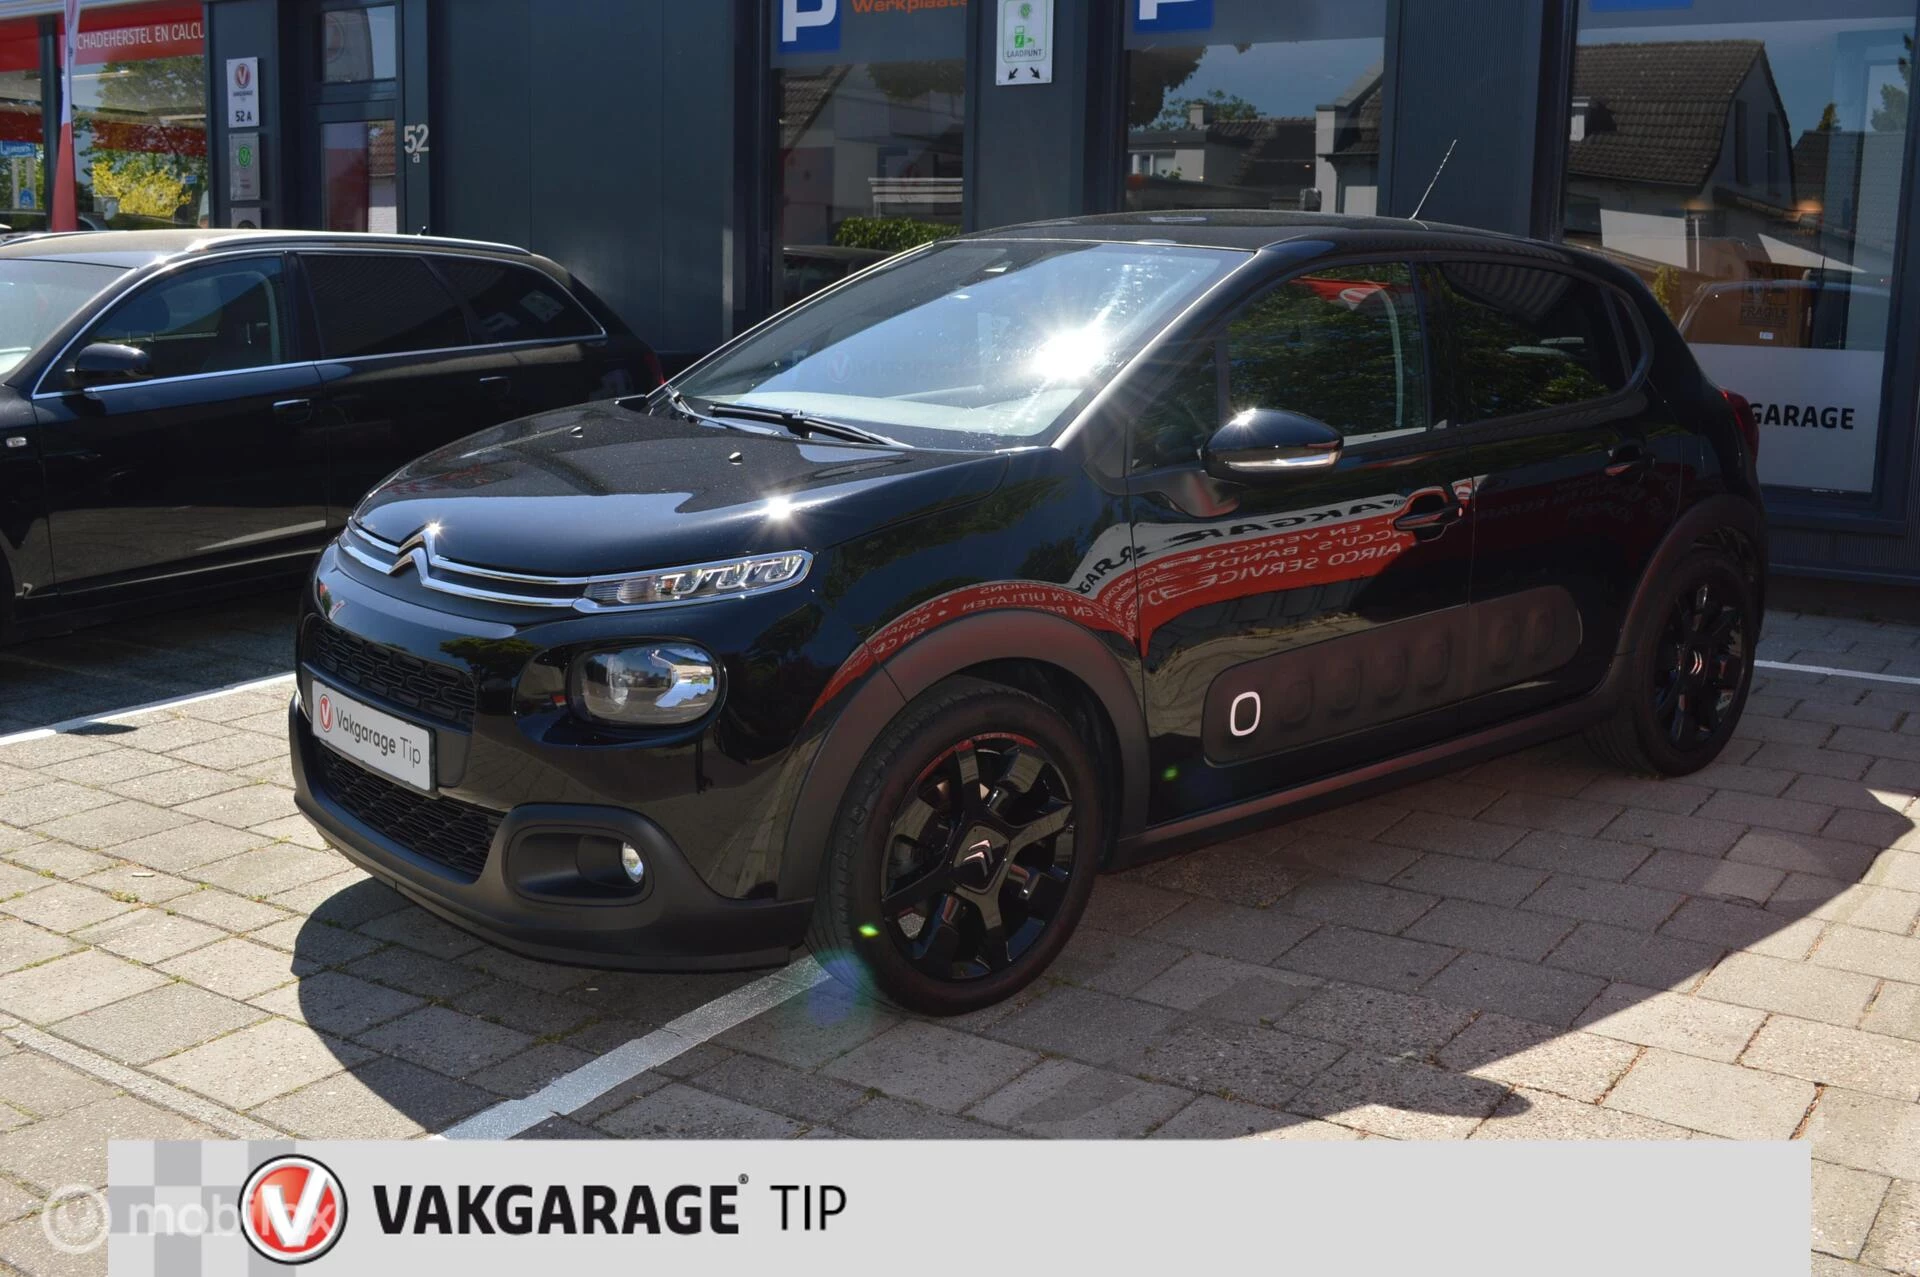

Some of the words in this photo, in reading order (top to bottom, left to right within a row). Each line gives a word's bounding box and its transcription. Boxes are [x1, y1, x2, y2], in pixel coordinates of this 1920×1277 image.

[77, 25, 153, 50] CHADEHERSTEL
[155, 25, 169, 42] EN
[1007, 48, 1043, 58] LAADPUNT
[235, 110, 245, 123] 52
[246, 110, 252, 122] A
[404, 123, 429, 154] 52
[412, 152, 420, 164] a
[336, 707, 396, 756] Vakgarage
[400, 736, 422, 768] Tip
